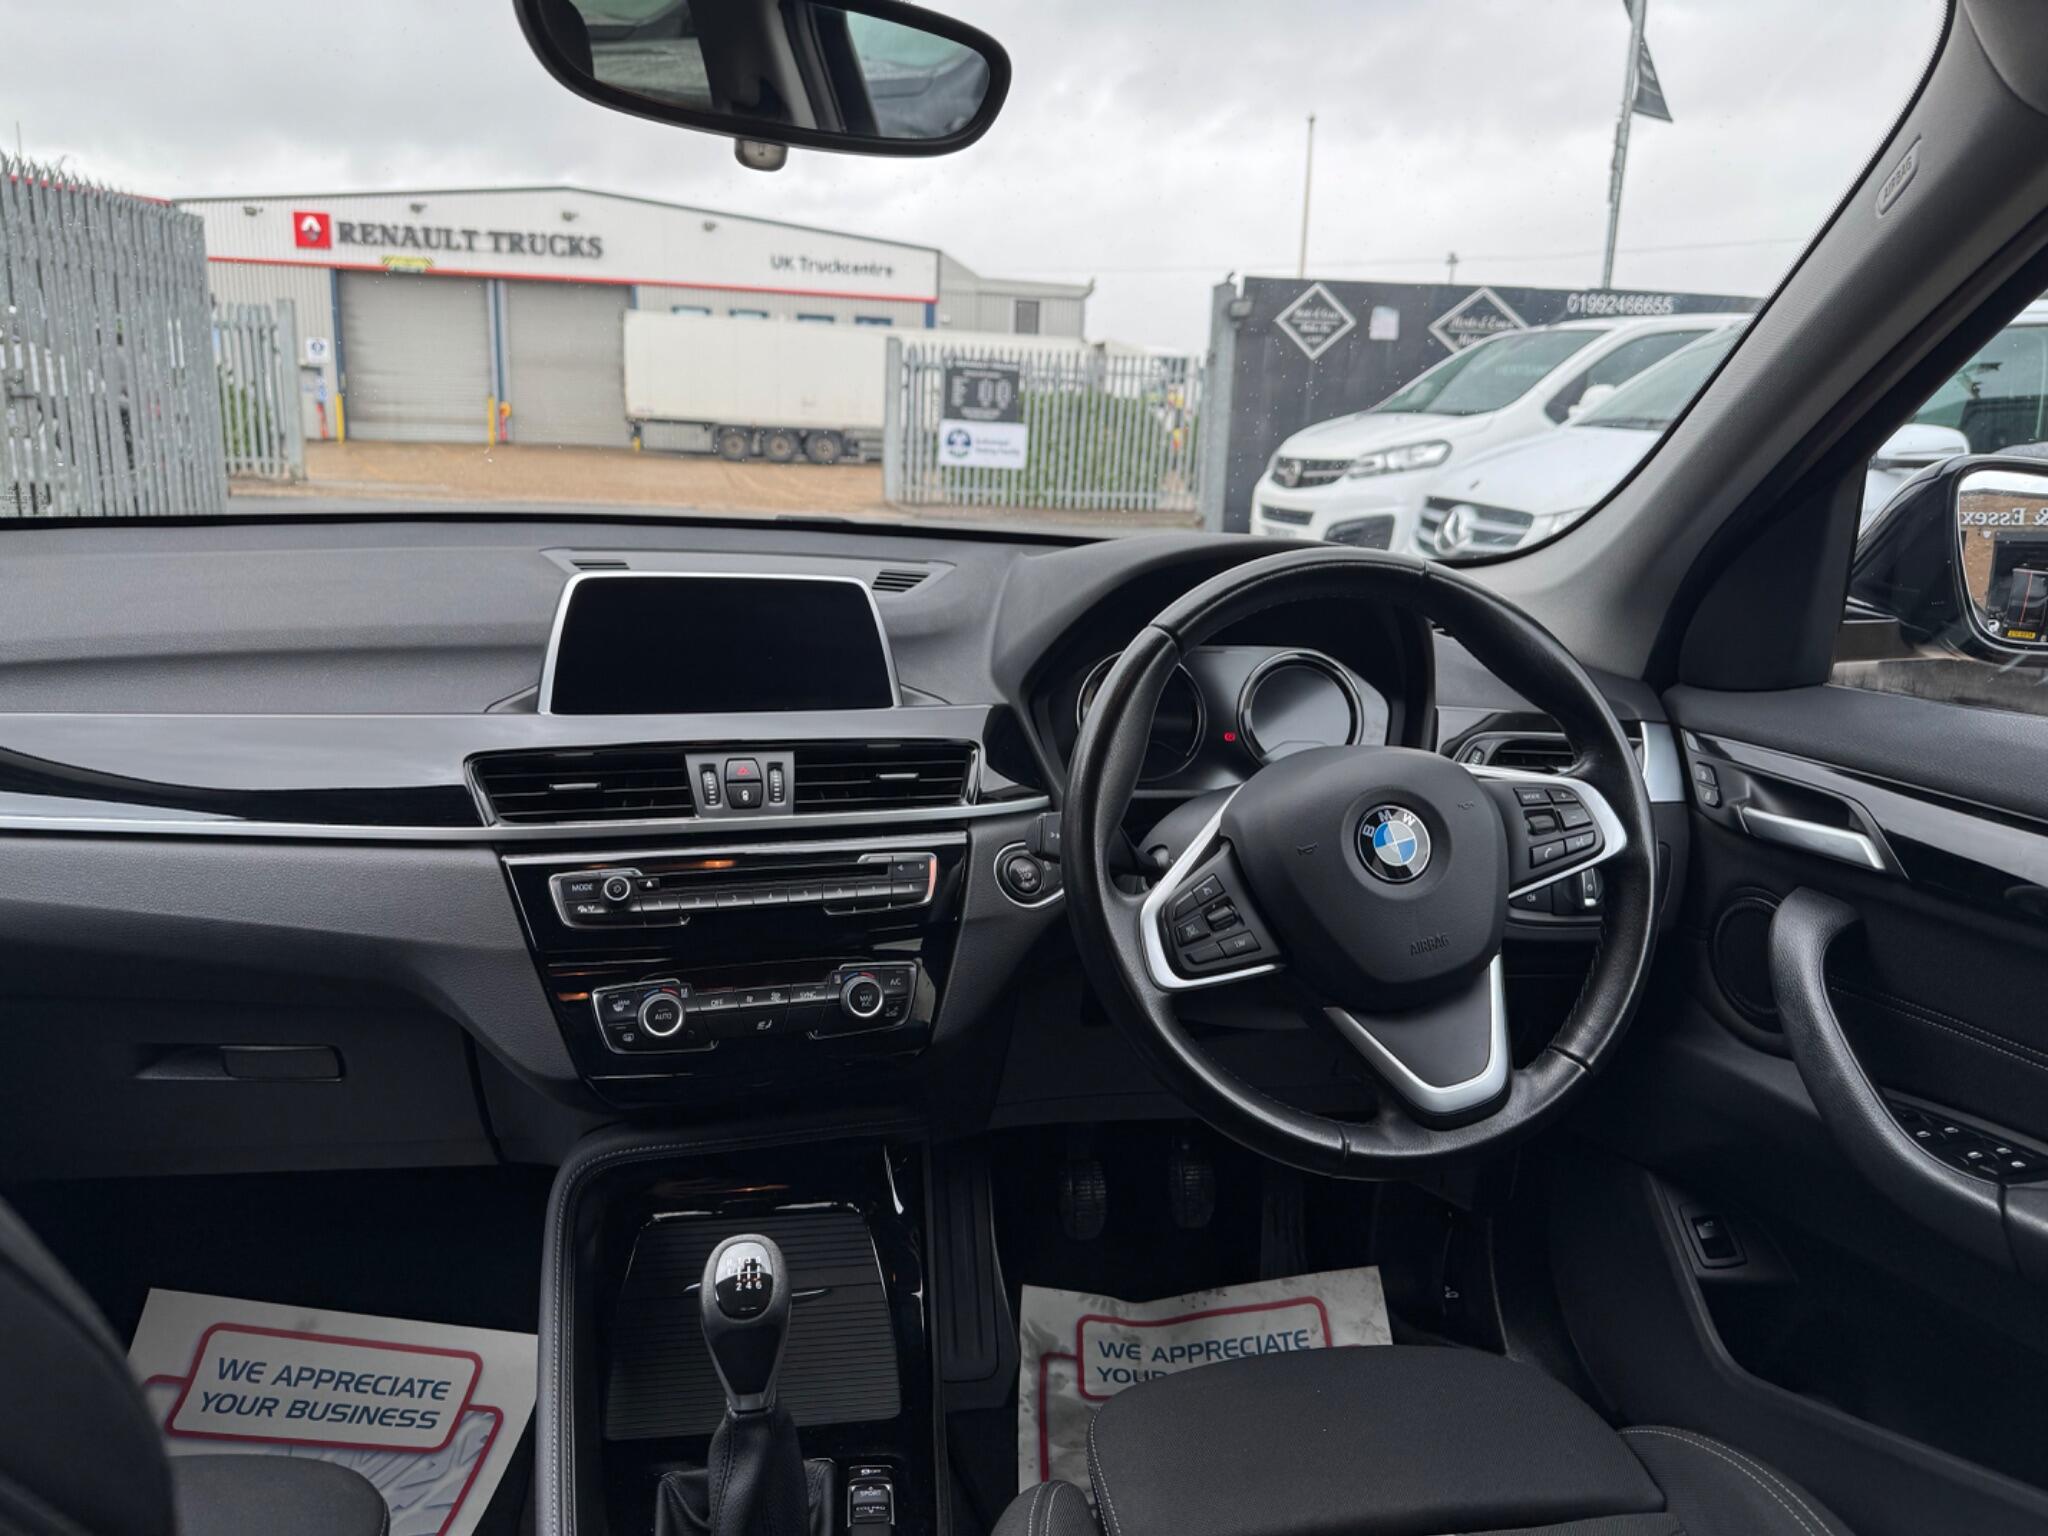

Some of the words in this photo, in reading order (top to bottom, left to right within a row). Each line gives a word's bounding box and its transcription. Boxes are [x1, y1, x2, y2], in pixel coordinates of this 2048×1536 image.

[1883, 156, 1913, 202] AIRBAG
[337, 221, 480, 251] RENAULT
[488, 230, 604, 259] TRUCKS
[770, 255, 794, 271] UK
[1362, 809, 1416, 838] BMW
[571, 883, 593, 892] MODE
[1410, 936, 1449, 956] AIRBAG
[710, 999, 723, 1008] OFF
[655, 1012, 672, 1020] AUTO
[736, 1282, 742, 1291] 2
[745, 1281, 752, 1290] 4
[755, 1281, 762, 1290] 6
[1098, 1340, 1141, 1360] WE
[1151, 1329, 1310, 1363] APPRECIATE
[218, 1356, 267, 1382] WE
[271, 1365, 452, 1400] APPRECIATE
[200, 1391, 280, 1418] YOUR
[285, 1400, 441, 1430] BUSINESS
